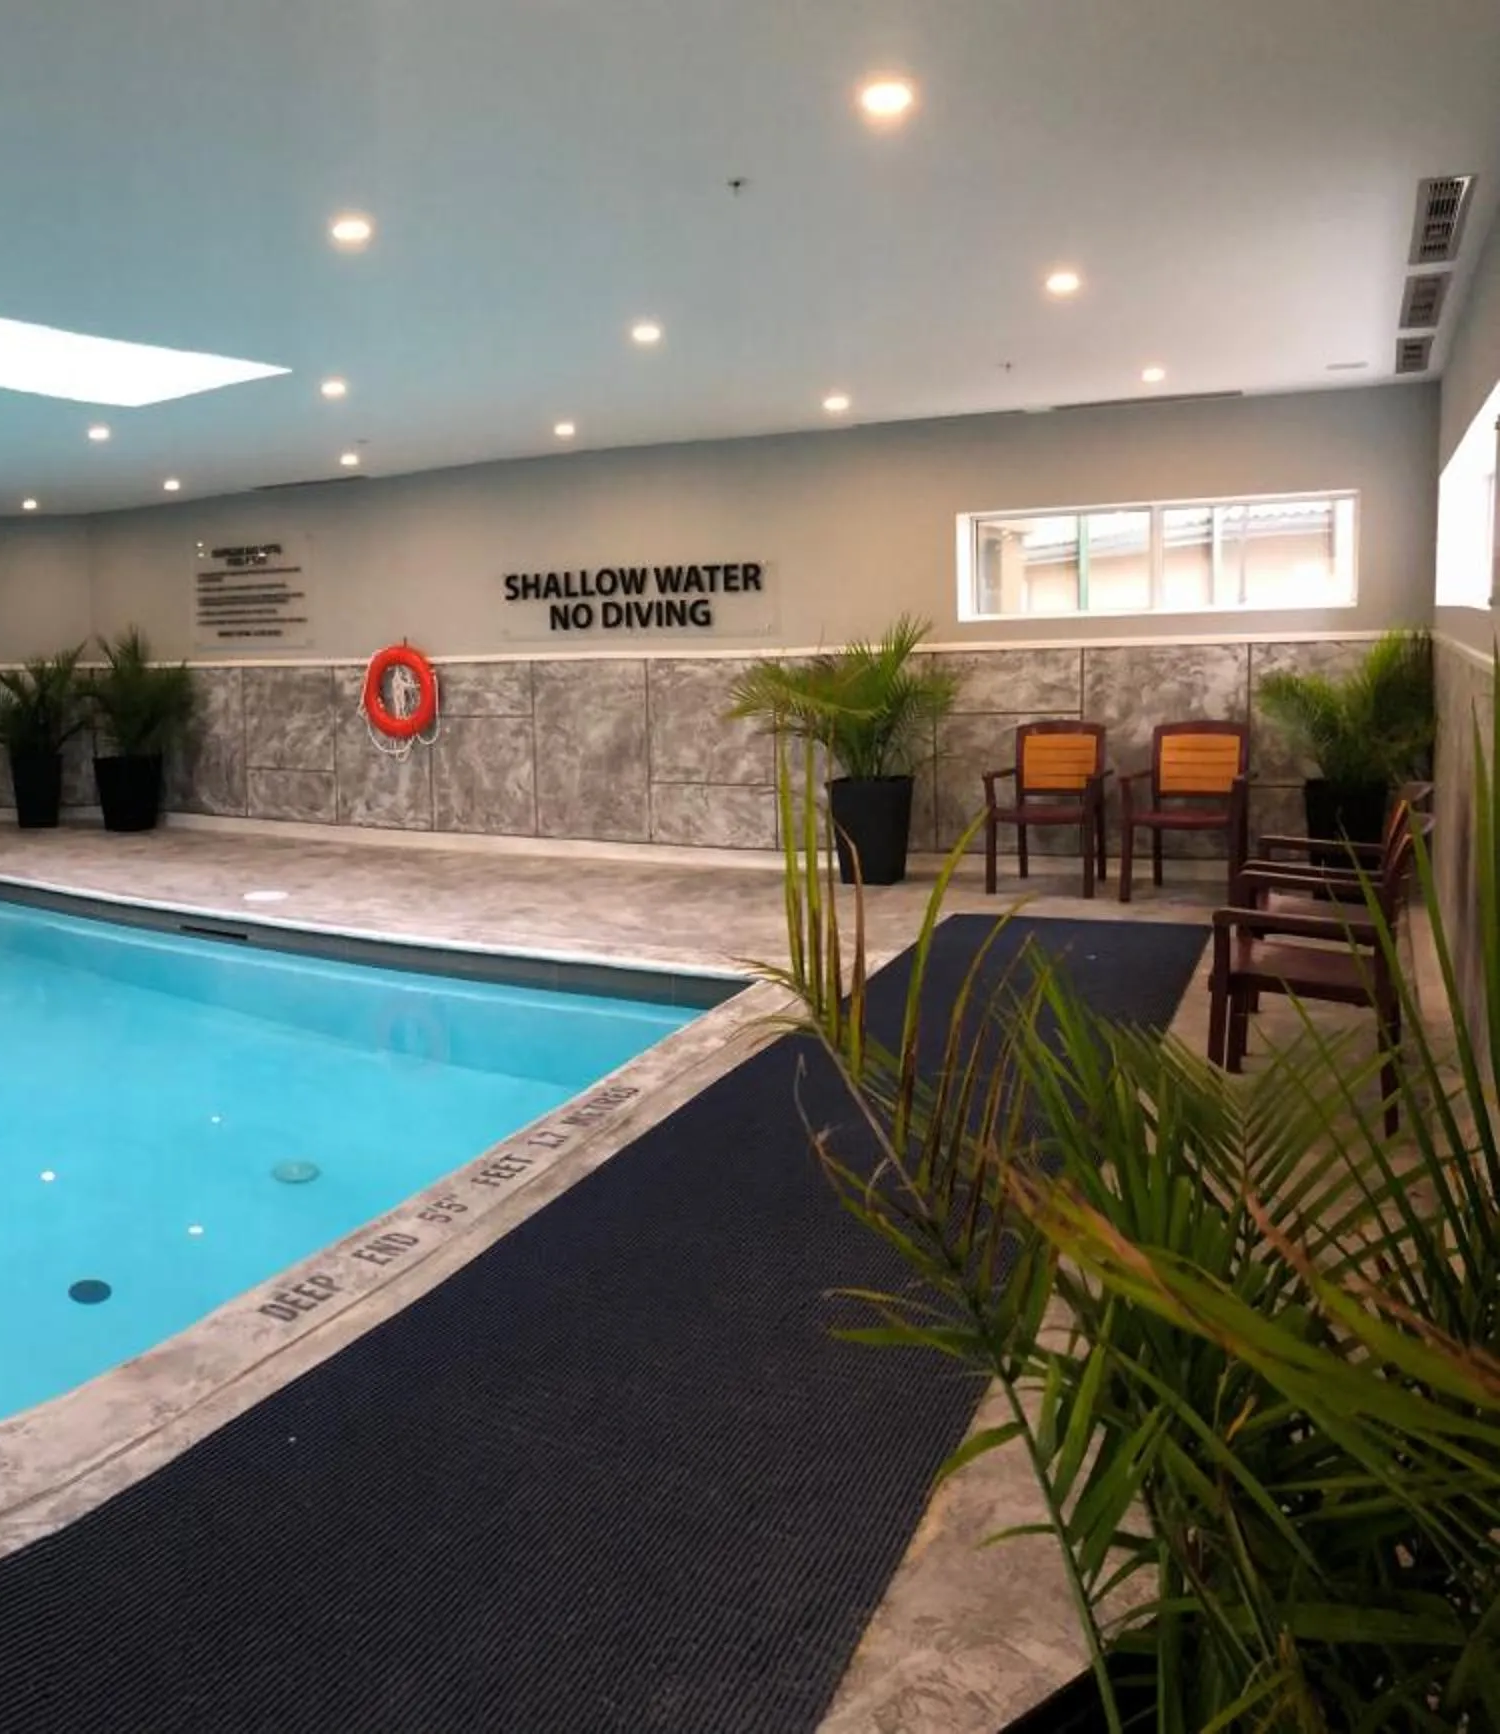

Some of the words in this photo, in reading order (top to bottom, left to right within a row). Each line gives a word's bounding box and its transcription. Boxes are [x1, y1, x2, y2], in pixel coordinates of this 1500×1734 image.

[504, 566, 647, 601] SHALLOW
[653, 563, 762, 594] WATER
[550, 603, 593, 630] NO
[602, 599, 711, 628] DIVING
[257, 1274, 345, 1323] DEEP
[351, 1231, 420, 1267] END
[471, 1153, 534, 1188] FEET
